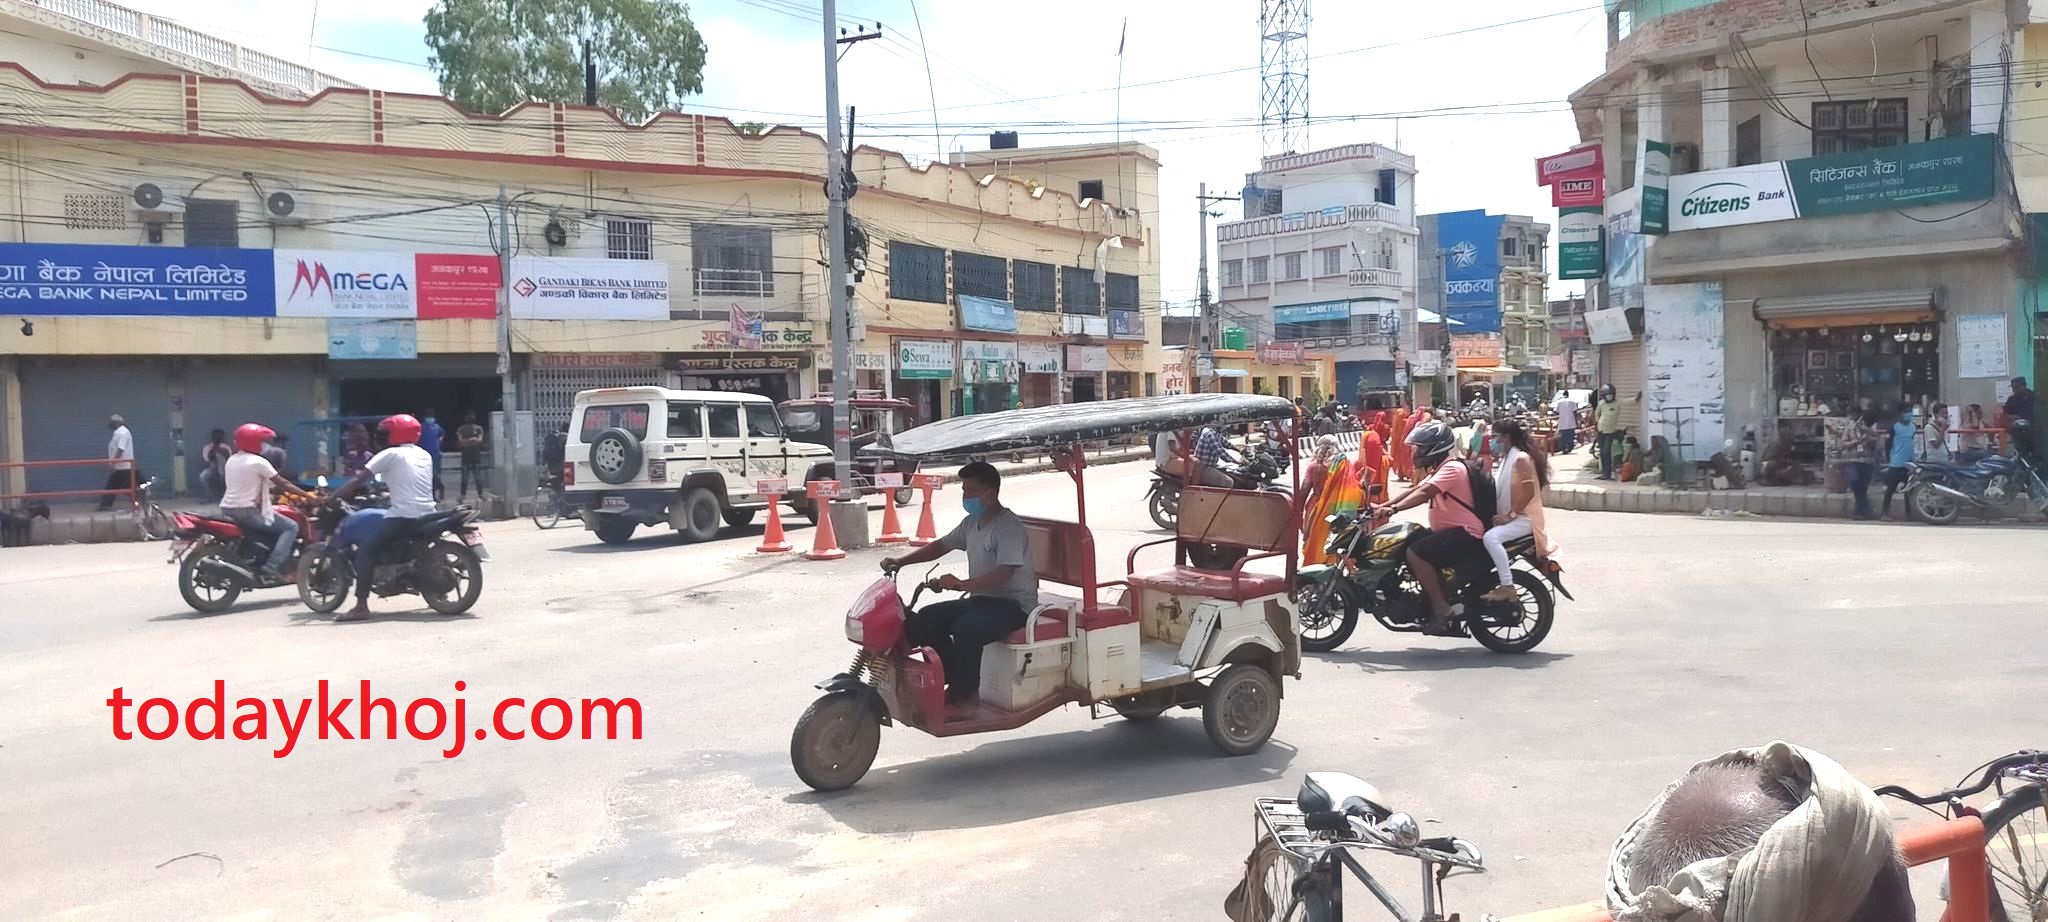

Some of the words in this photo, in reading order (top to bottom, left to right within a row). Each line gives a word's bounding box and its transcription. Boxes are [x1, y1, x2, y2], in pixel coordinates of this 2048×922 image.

[1809, 164, 1867, 184] सिटिजन्स
[1872, 158, 1897, 176] बैंक
[1681, 195, 1751, 217] Citizens
[1758, 189, 1786, 201] Bank
[38, 258, 82, 282] बैंक
[93, 261, 155, 283] नेपाल
[165, 264, 248, 285] लिमिटेड
[333, 273, 409, 291] MEGA
[538, 276, 579, 287] GANDAKI
[582, 278, 607, 287] BIKAS
[609, 278, 632, 288] BANK
[633, 278, 667, 289] LIMITED
[0, 287, 32, 300] EGA
[39, 287, 93, 300] BANK
[100, 288, 168, 301] NEPAL
[174, 289, 248, 302] LIMITED
[702, 329, 730, 344] गुप्त
